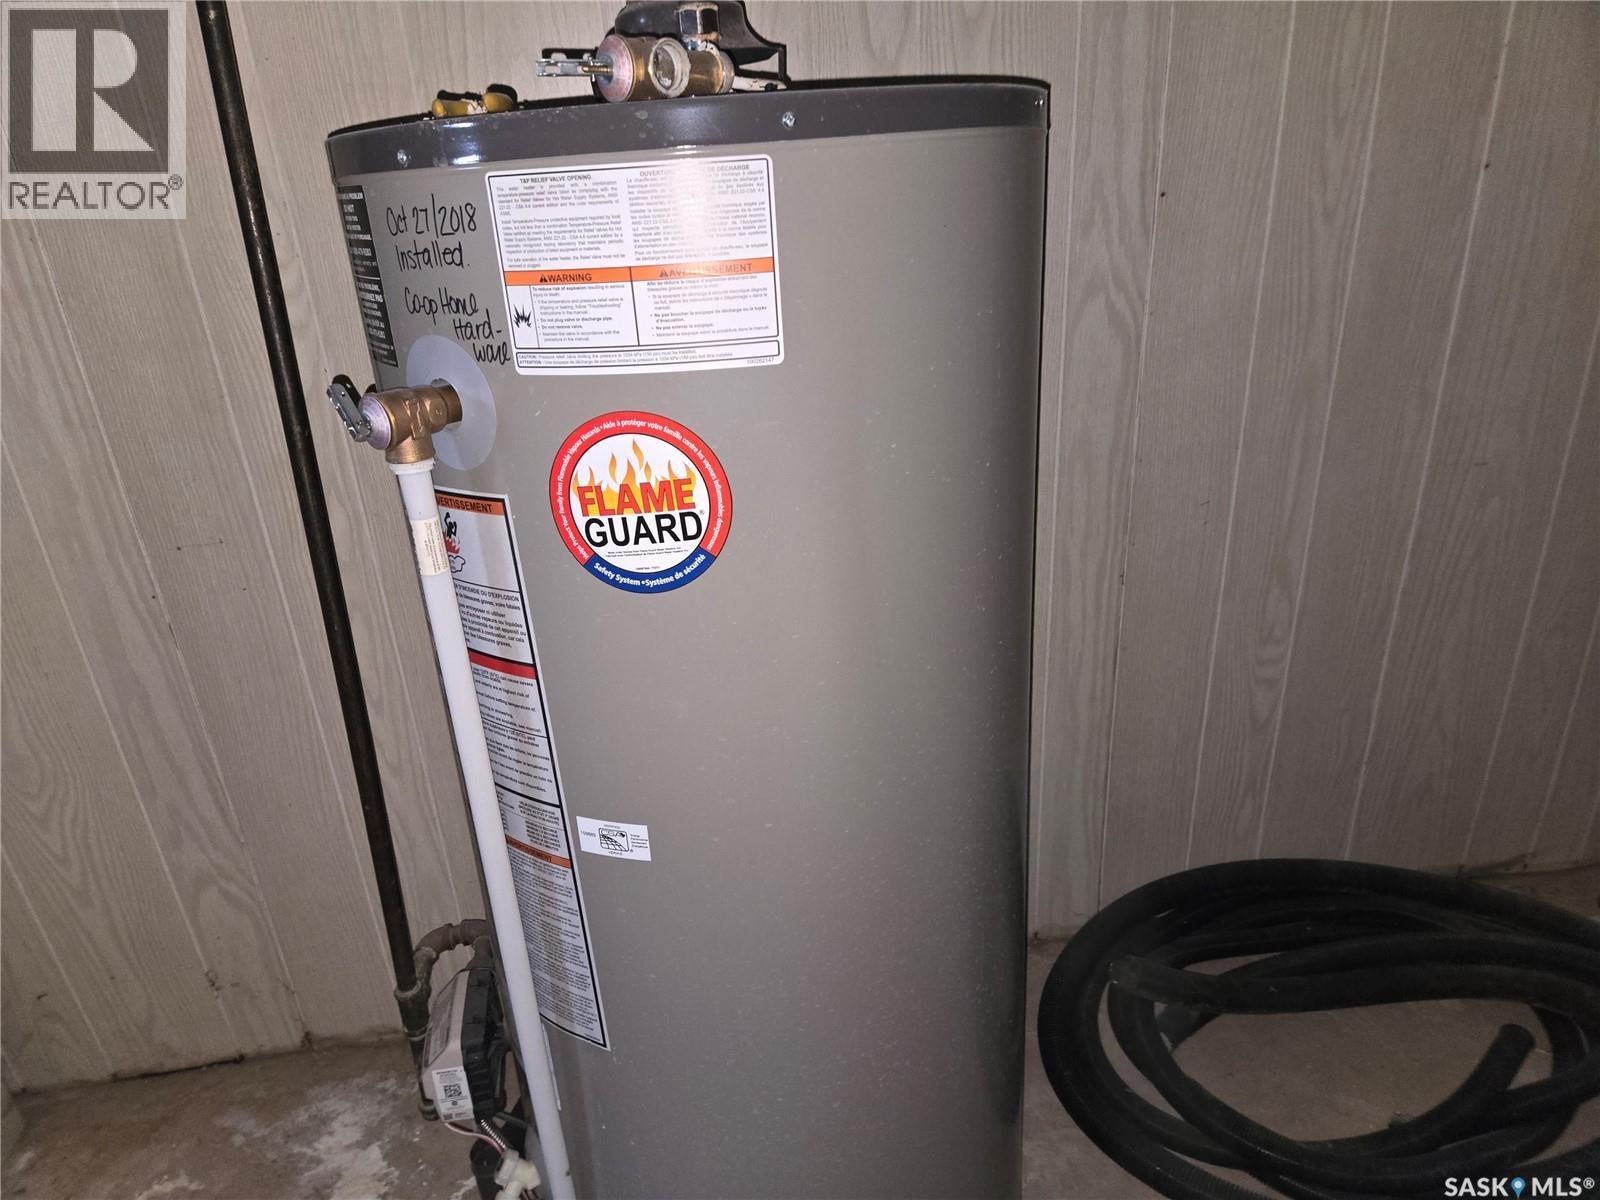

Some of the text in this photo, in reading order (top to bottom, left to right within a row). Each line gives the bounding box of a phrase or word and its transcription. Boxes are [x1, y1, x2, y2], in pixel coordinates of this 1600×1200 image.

[386, 193, 477, 238] Oct 27/2018
[396, 240, 470, 272] Installed.
[547, 274, 592, 282] WARNING
[439, 287, 479, 316] Home
[472, 341, 511, 365] ware
[603, 421, 616, 429] Aide
[621, 419, 647, 428] protéger
[648, 422, 663, 431] votre
[663, 426, 682, 440] famille
[682, 438, 698, 453] contre
[696, 450, 705, 460] les
[703, 459, 717, 480] vapeurs
[577, 478, 696, 517] FLAME
[584, 511, 702, 547] GUARD
[594, 562, 615, 580] Safety
[615, 574, 640, 586] System
[645, 576, 674, 587] Système
[683, 554, 706, 575] sécurité
